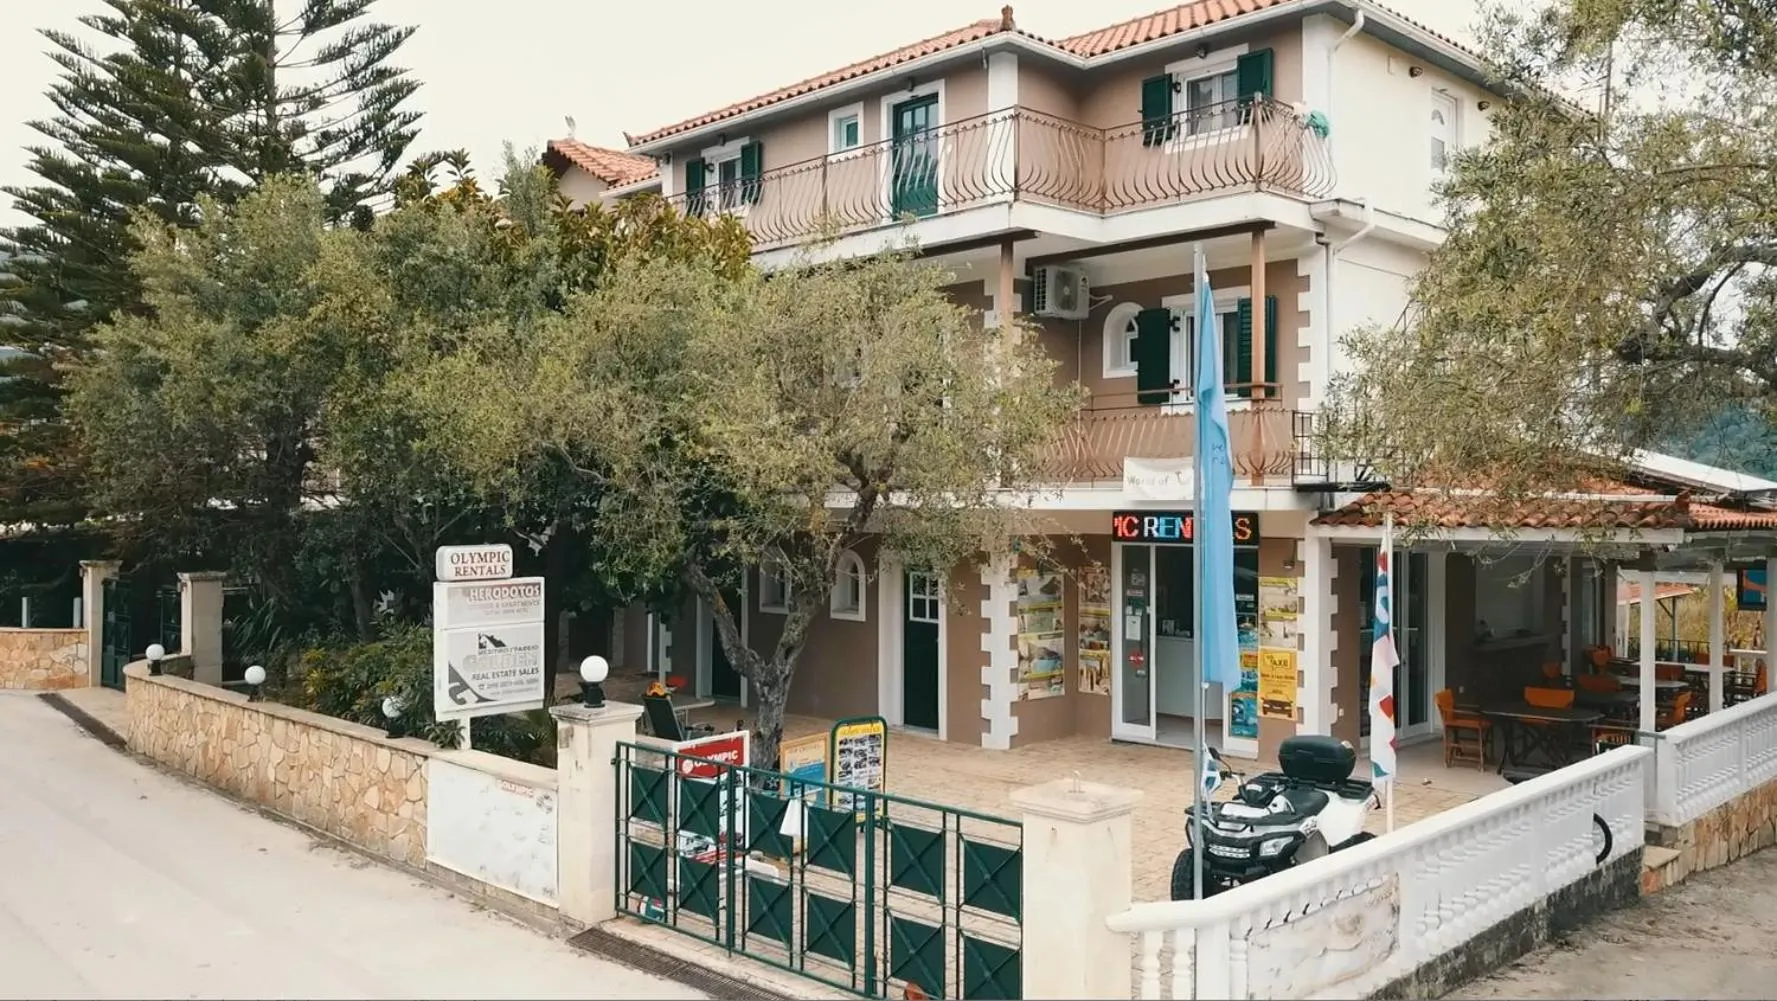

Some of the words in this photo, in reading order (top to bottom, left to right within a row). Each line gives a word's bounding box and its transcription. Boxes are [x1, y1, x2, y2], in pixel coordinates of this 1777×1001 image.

[450, 550, 510, 565] OLYMPIC
[455, 565, 506, 577] RENTALS
[469, 585, 540, 601] HERODOTOS
[471, 673, 491, 681] REAL
[492, 669, 517, 680] ESTATE
[519, 667, 540, 677] SALES
